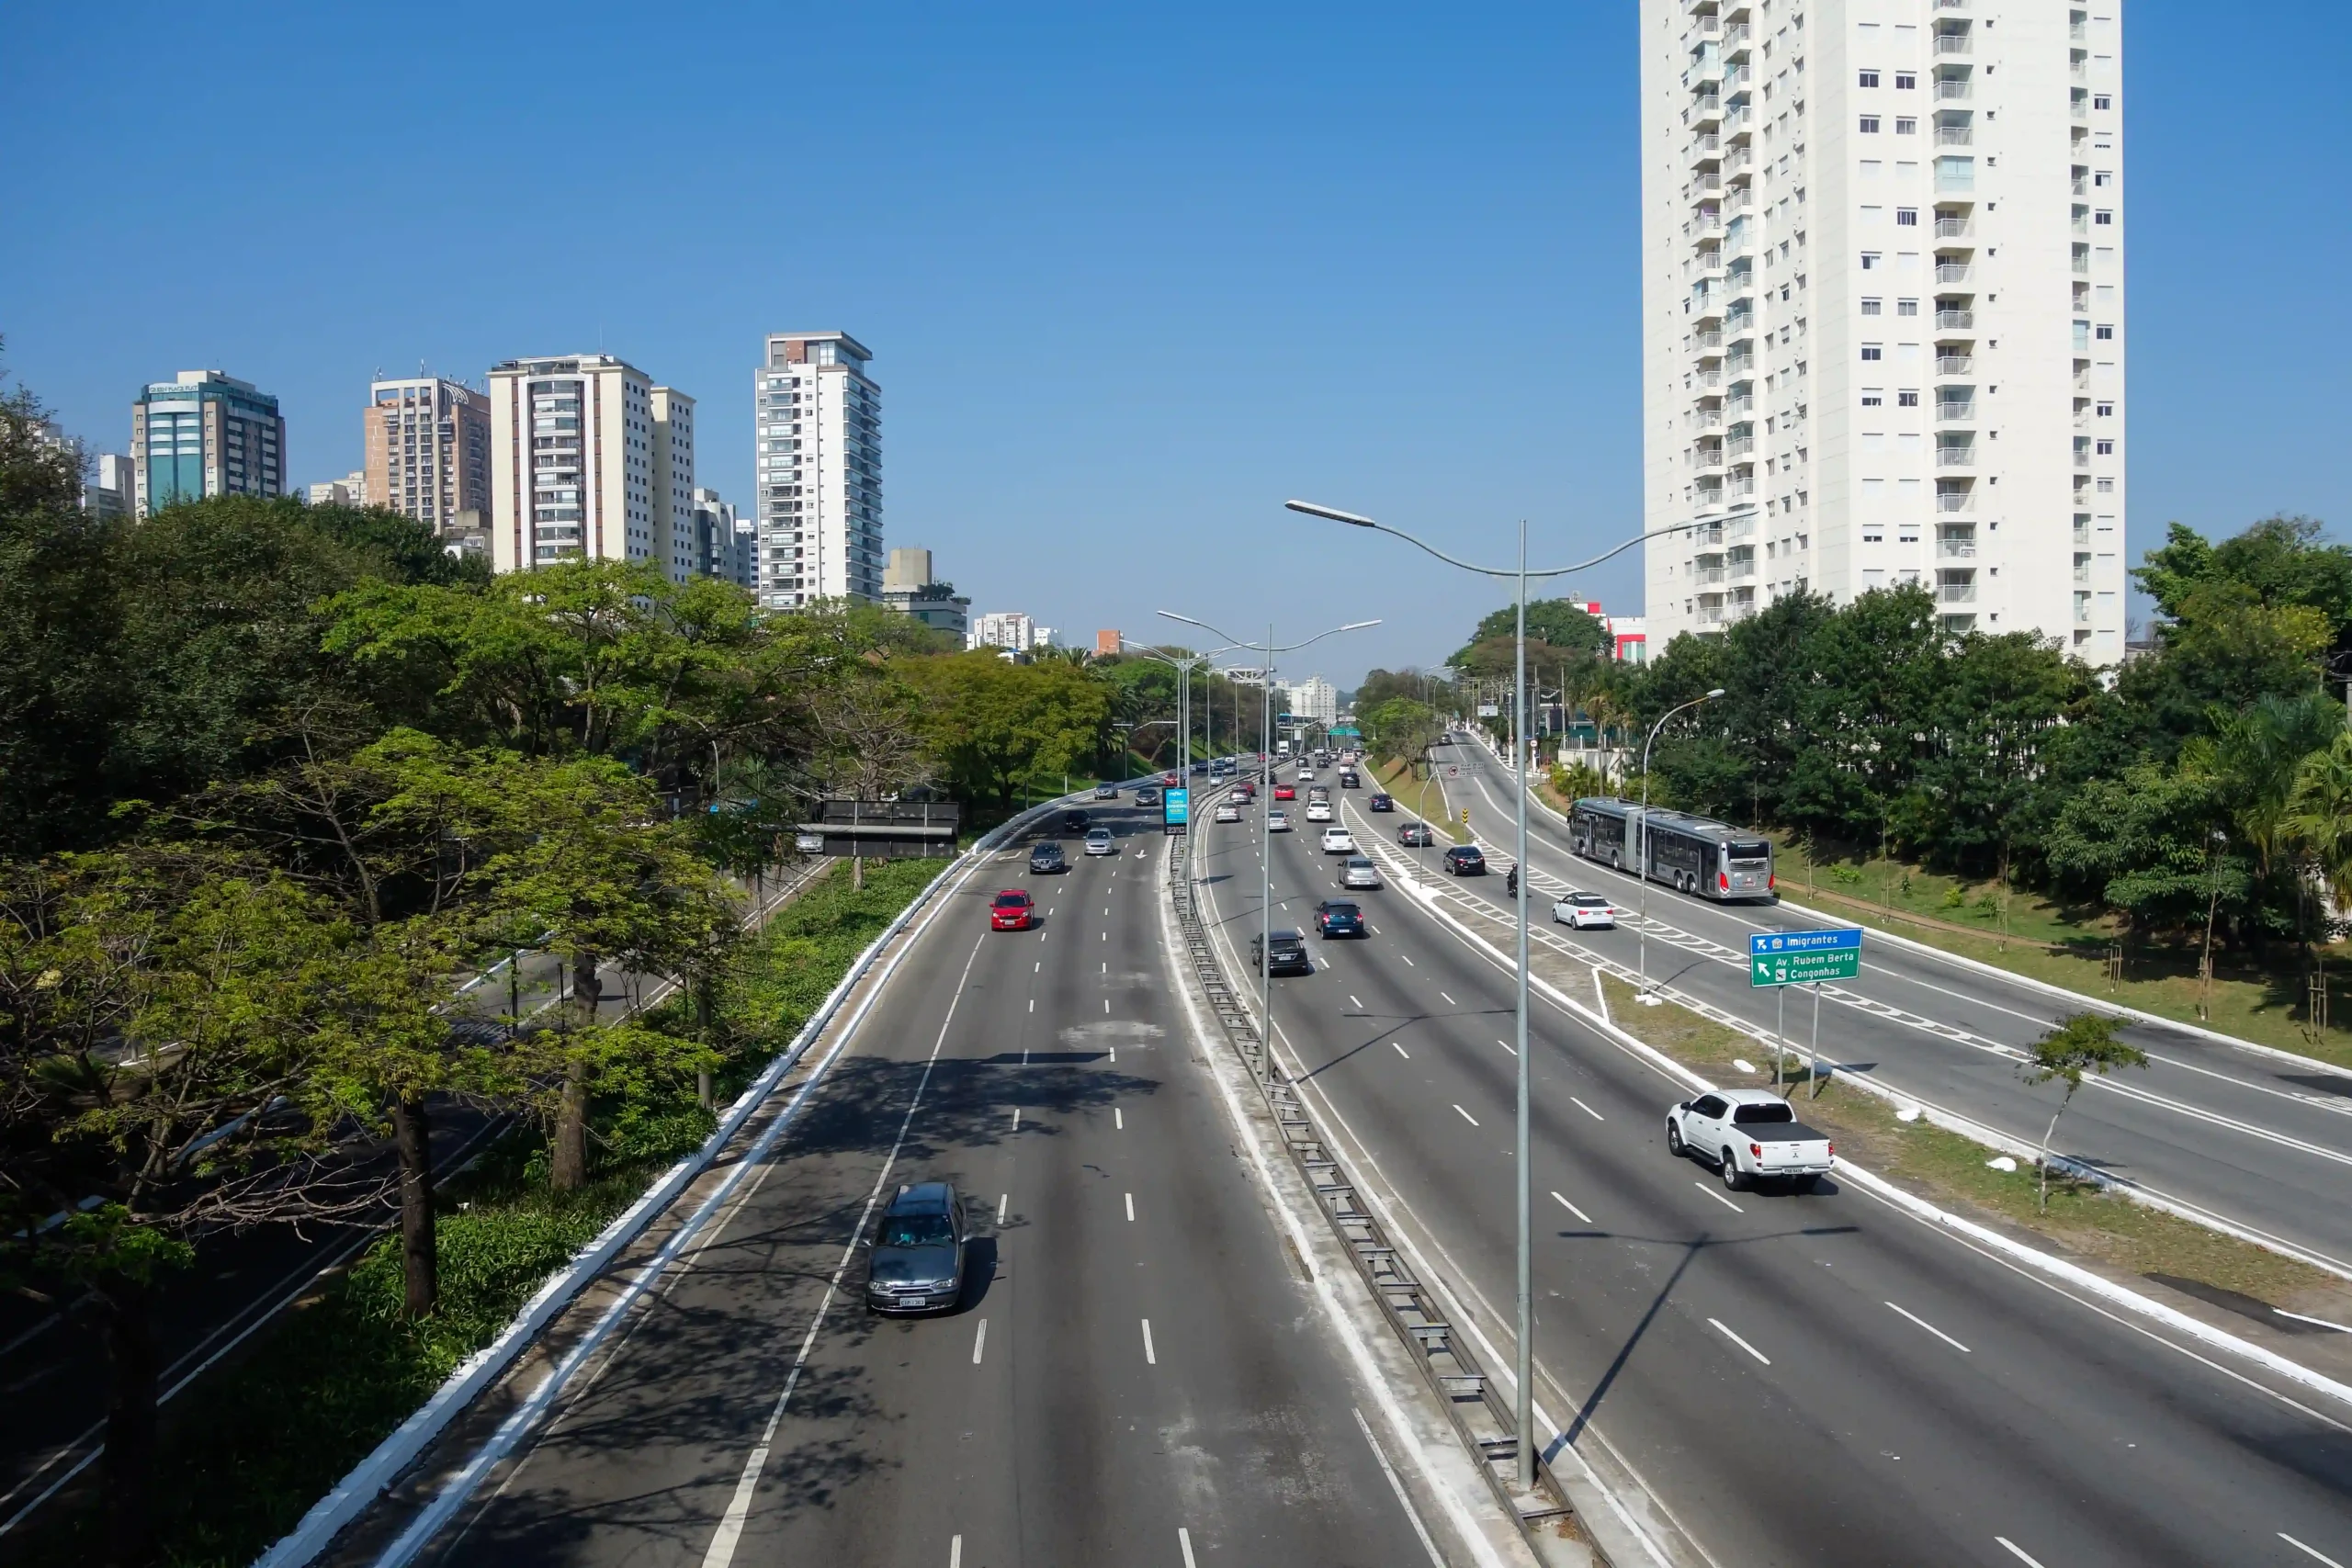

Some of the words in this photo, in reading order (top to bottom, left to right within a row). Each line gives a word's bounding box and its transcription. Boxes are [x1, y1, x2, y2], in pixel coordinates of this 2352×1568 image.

[1787, 935, 1838, 947] Imigrantes
[1776, 958, 1790, 966] Av.
[1793, 956, 1825, 965] Rubem
[1827, 953, 1854, 963] Berta
[1791, 967, 1840, 979] Congonhas
